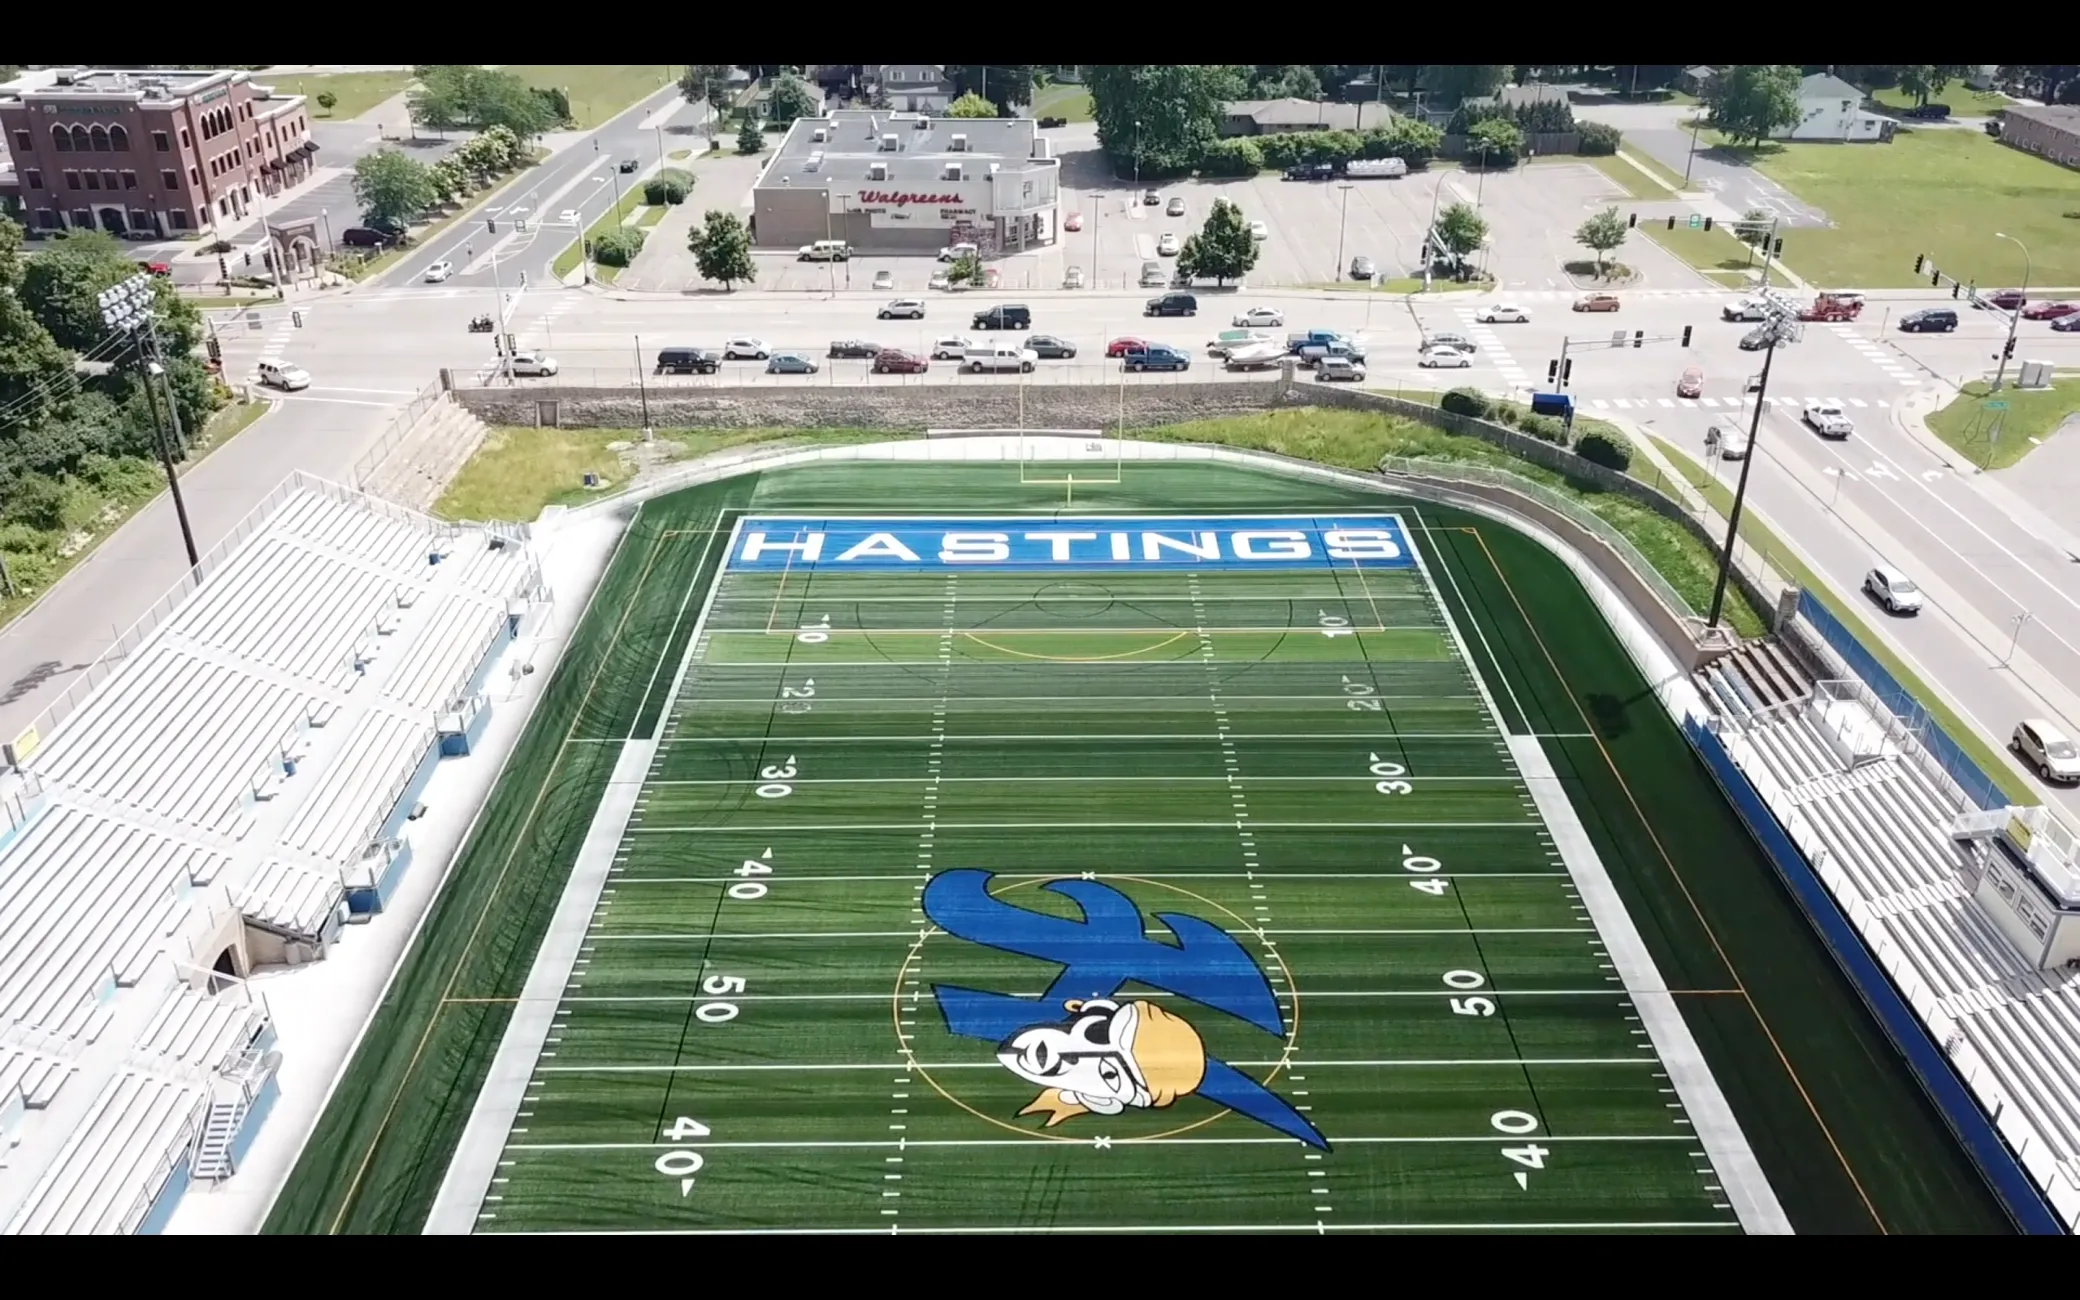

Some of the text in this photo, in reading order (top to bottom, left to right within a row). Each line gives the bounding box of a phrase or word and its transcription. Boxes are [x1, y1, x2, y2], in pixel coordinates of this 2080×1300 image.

[857, 190, 964, 208] Walgreens
[740, 530, 1401, 562] HASTINGS
[797, 622, 831, 643] 10
[1318, 616, 1353, 638] 10
[781, 686, 816, 714] 20
[1343, 683, 1382, 711] 20
[755, 765, 797, 798] 30
[1369, 762, 1413, 795] 30
[728, 859, 773, 900] 40
[1402, 856, 1449, 896] 40
[695, 975, 746, 1023] 50
[1442, 969, 1496, 1017] 50
[654, 1116, 711, 1176] 40
[1490, 1110, 1550, 1169] 40
